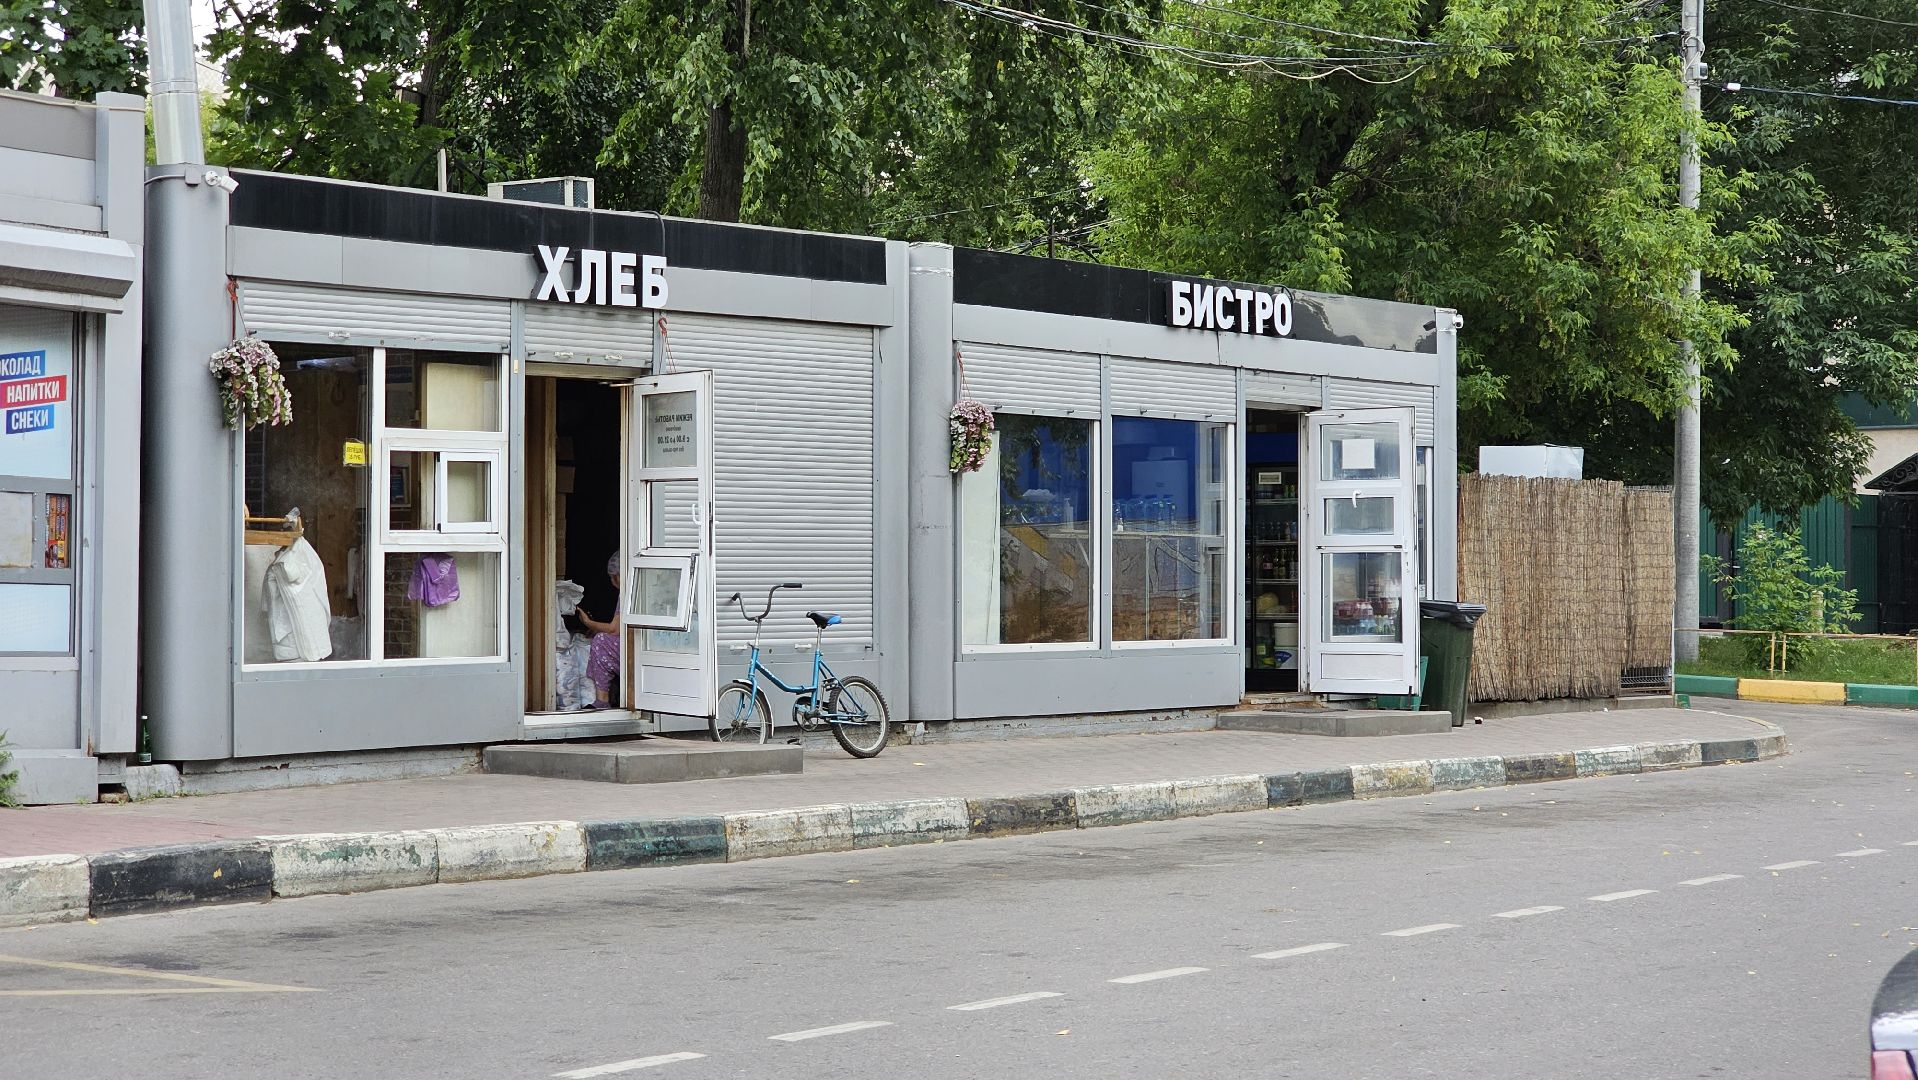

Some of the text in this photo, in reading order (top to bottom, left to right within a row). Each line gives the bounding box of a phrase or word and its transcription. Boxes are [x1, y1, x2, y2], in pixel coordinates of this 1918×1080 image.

[537, 244, 669, 309] ХЛЕБ
[1172, 281, 1292, 335] БИСТРО
[0, 355, 41, 377] КОЛАД
[7, 380, 60, 403] НАПИТКИ
[11, 408, 49, 430] СНЕКИ
